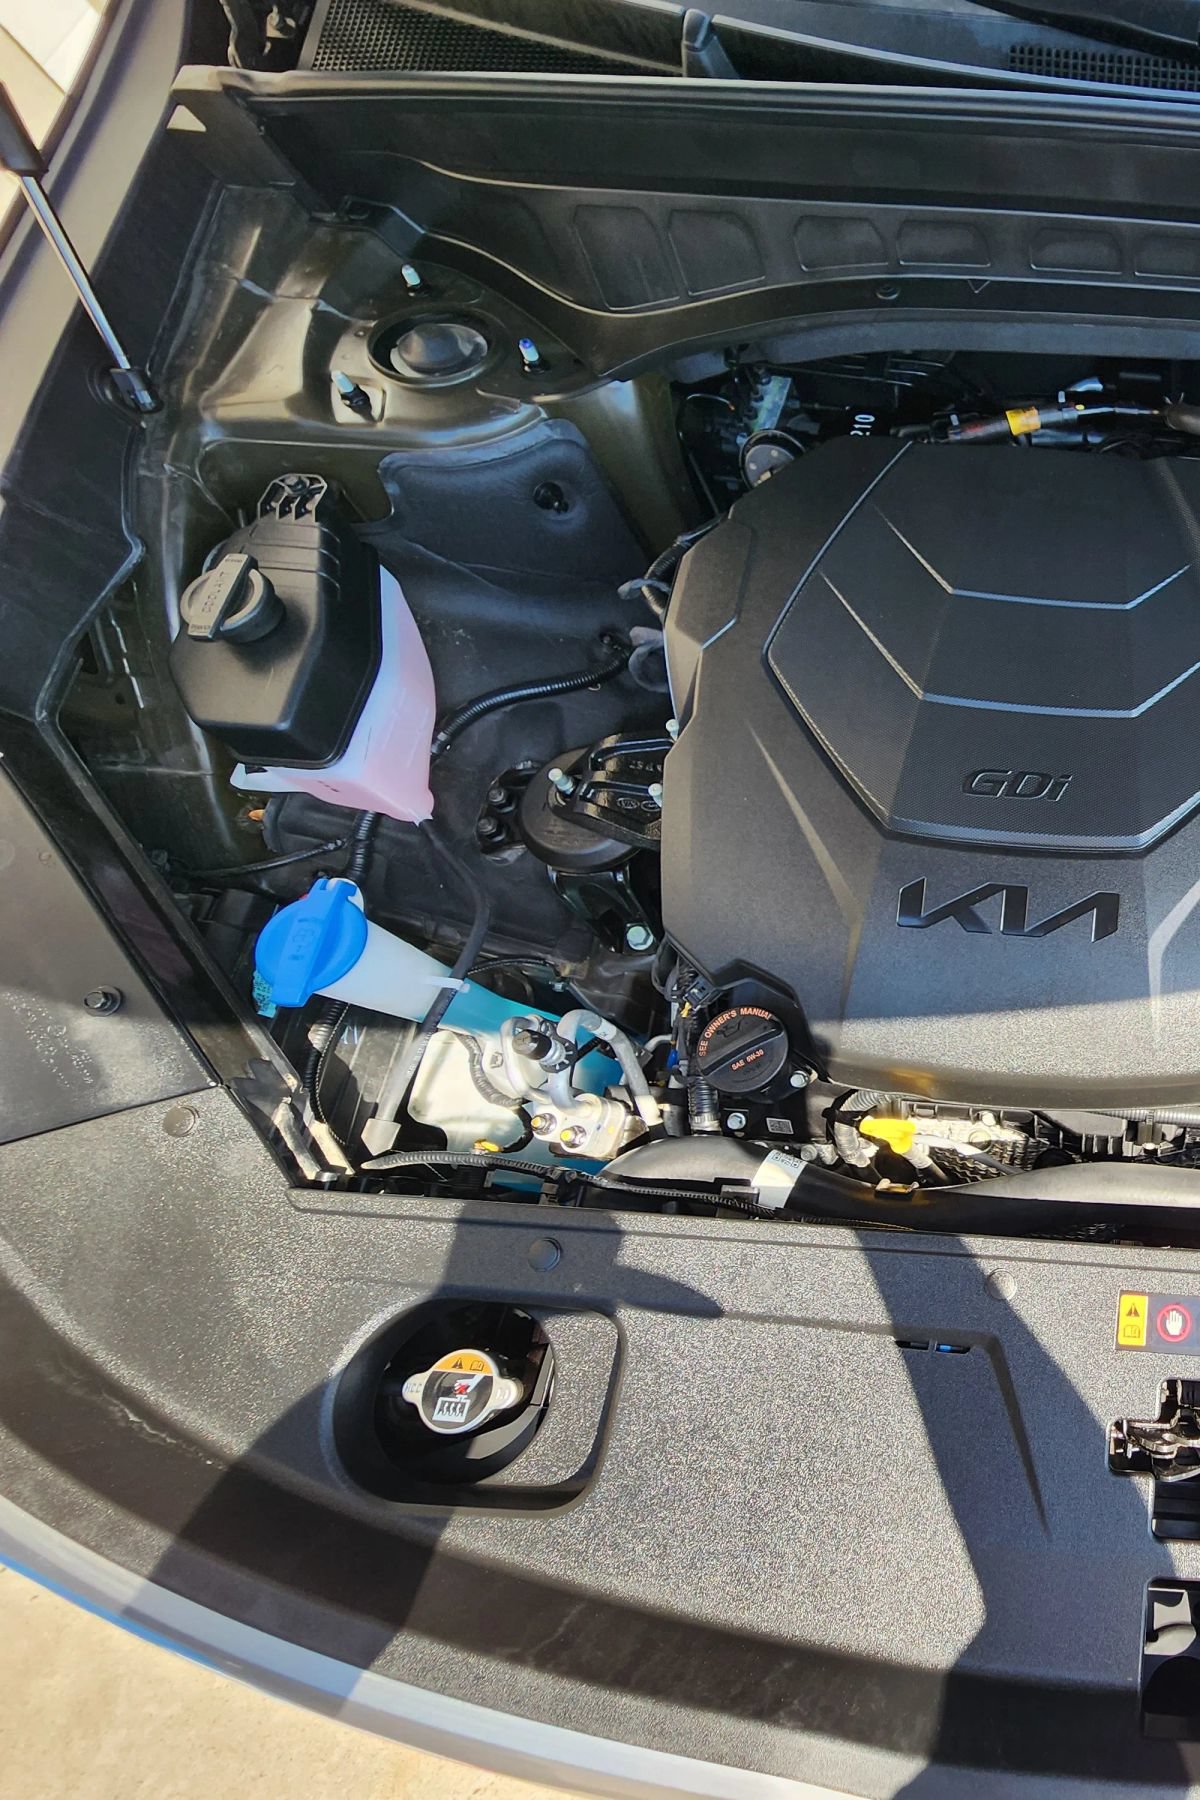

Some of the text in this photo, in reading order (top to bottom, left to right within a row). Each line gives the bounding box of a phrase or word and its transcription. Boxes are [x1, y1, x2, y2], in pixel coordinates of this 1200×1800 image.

[961, 768, 1073, 802] GDi
[897, 876, 1121, 943] KIA
[699, 1040, 708, 1056] SEE
[704, 1010, 737, 1038] OWNER'S
[731, 1060, 745, 1071] SAE
